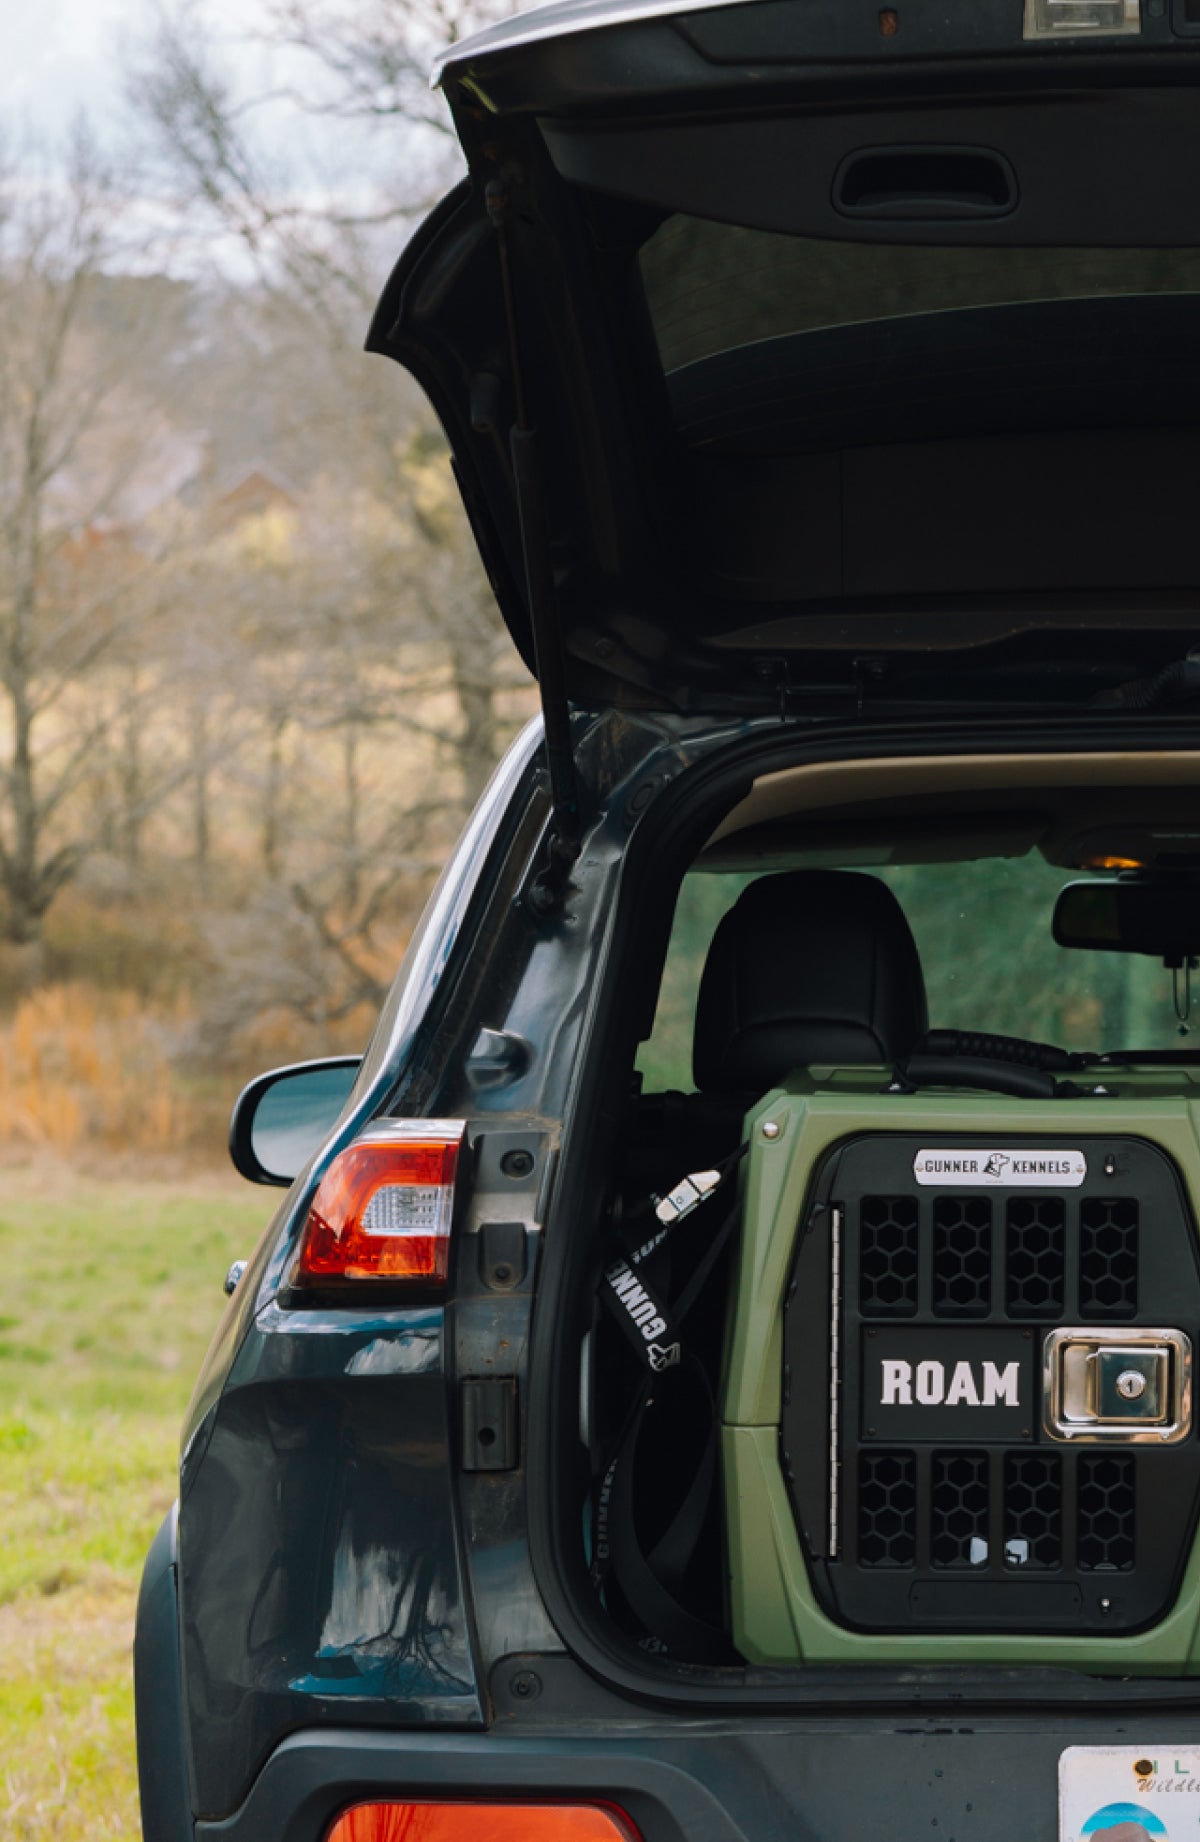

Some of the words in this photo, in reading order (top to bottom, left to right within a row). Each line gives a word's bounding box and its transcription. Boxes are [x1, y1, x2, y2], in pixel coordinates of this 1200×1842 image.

[924, 1159, 979, 1173] GUNNER
[1012, 1159, 1071, 1174] KENNELS
[880, 1358, 1020, 1407] ROAM
